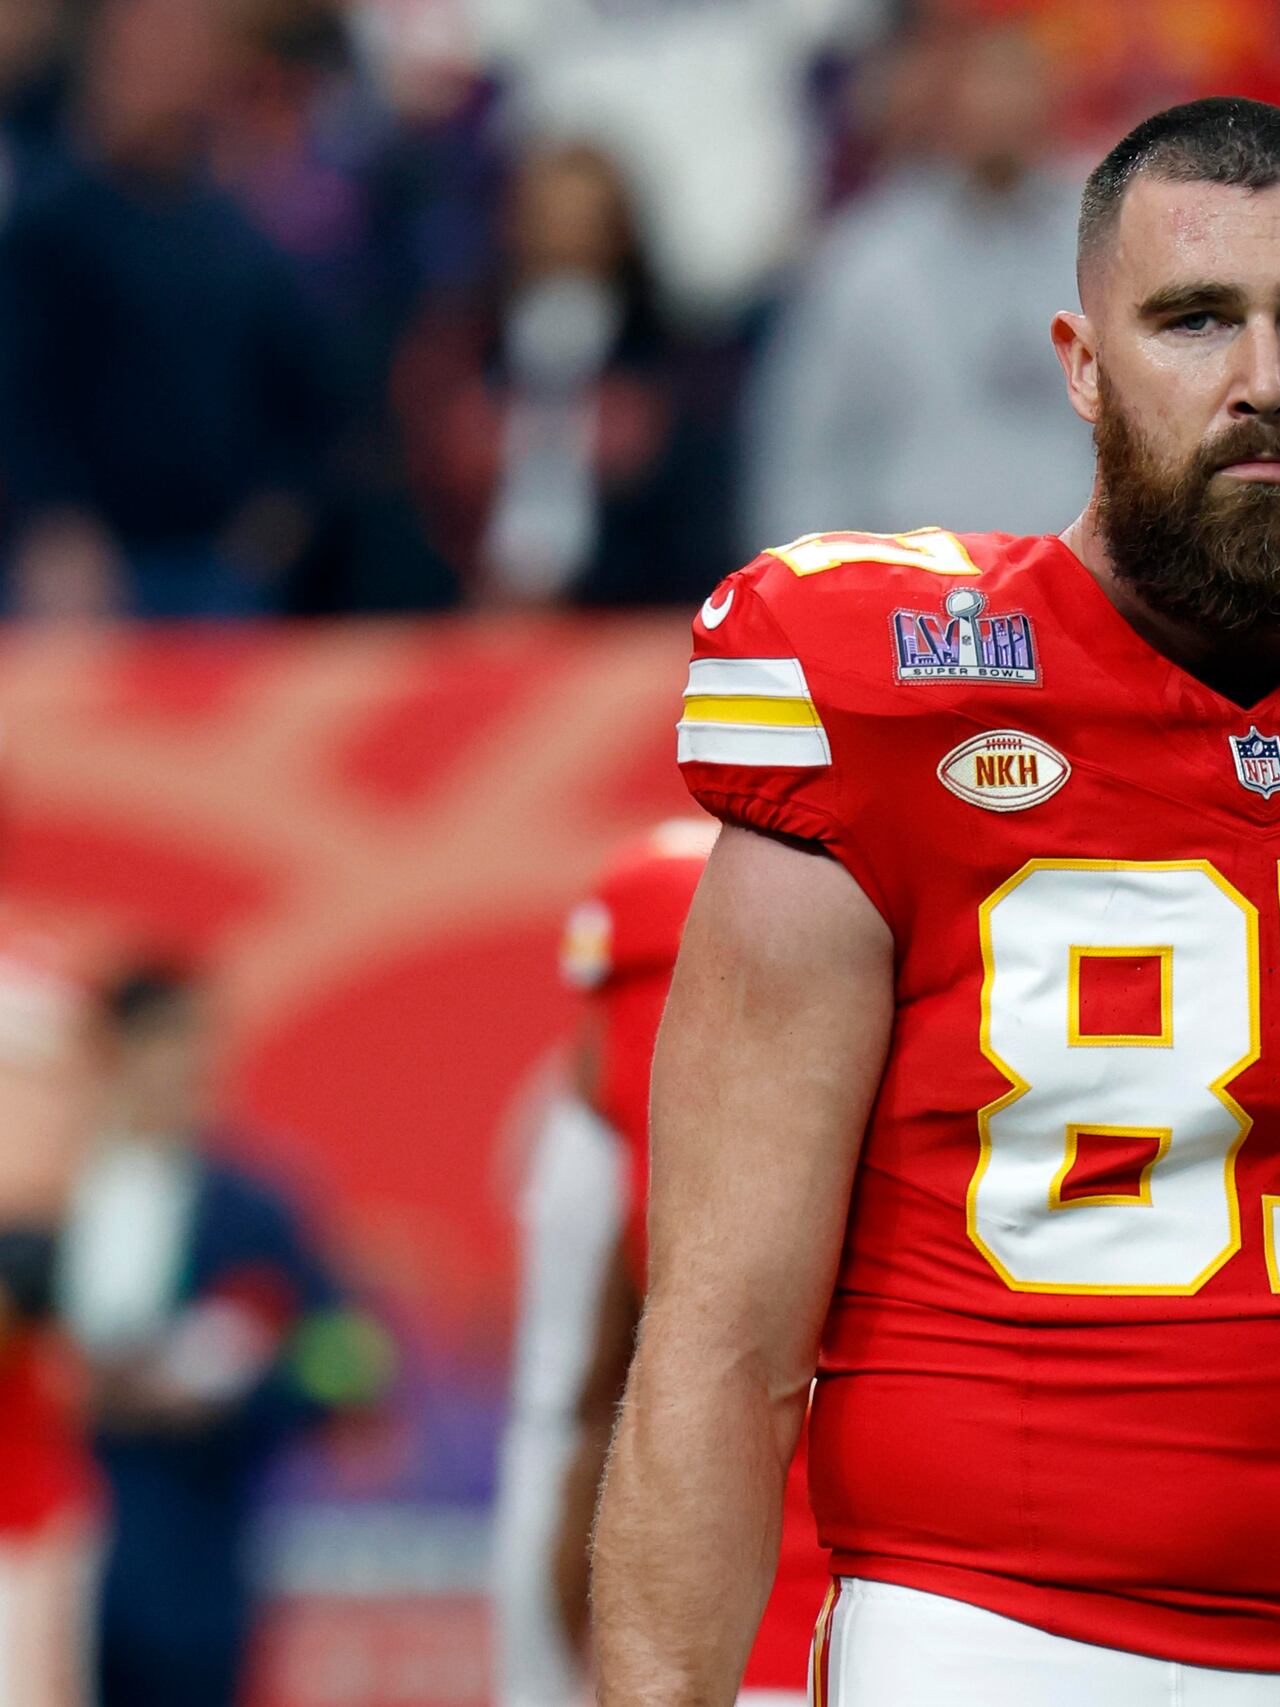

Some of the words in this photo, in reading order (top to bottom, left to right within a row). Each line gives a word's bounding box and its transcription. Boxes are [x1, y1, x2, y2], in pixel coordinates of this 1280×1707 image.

[912, 667, 969, 677] SUPER
[978, 668, 1025, 679] BOWL
[975, 753, 1039, 787] NKH
[1244, 759, 1280, 785] NFL
